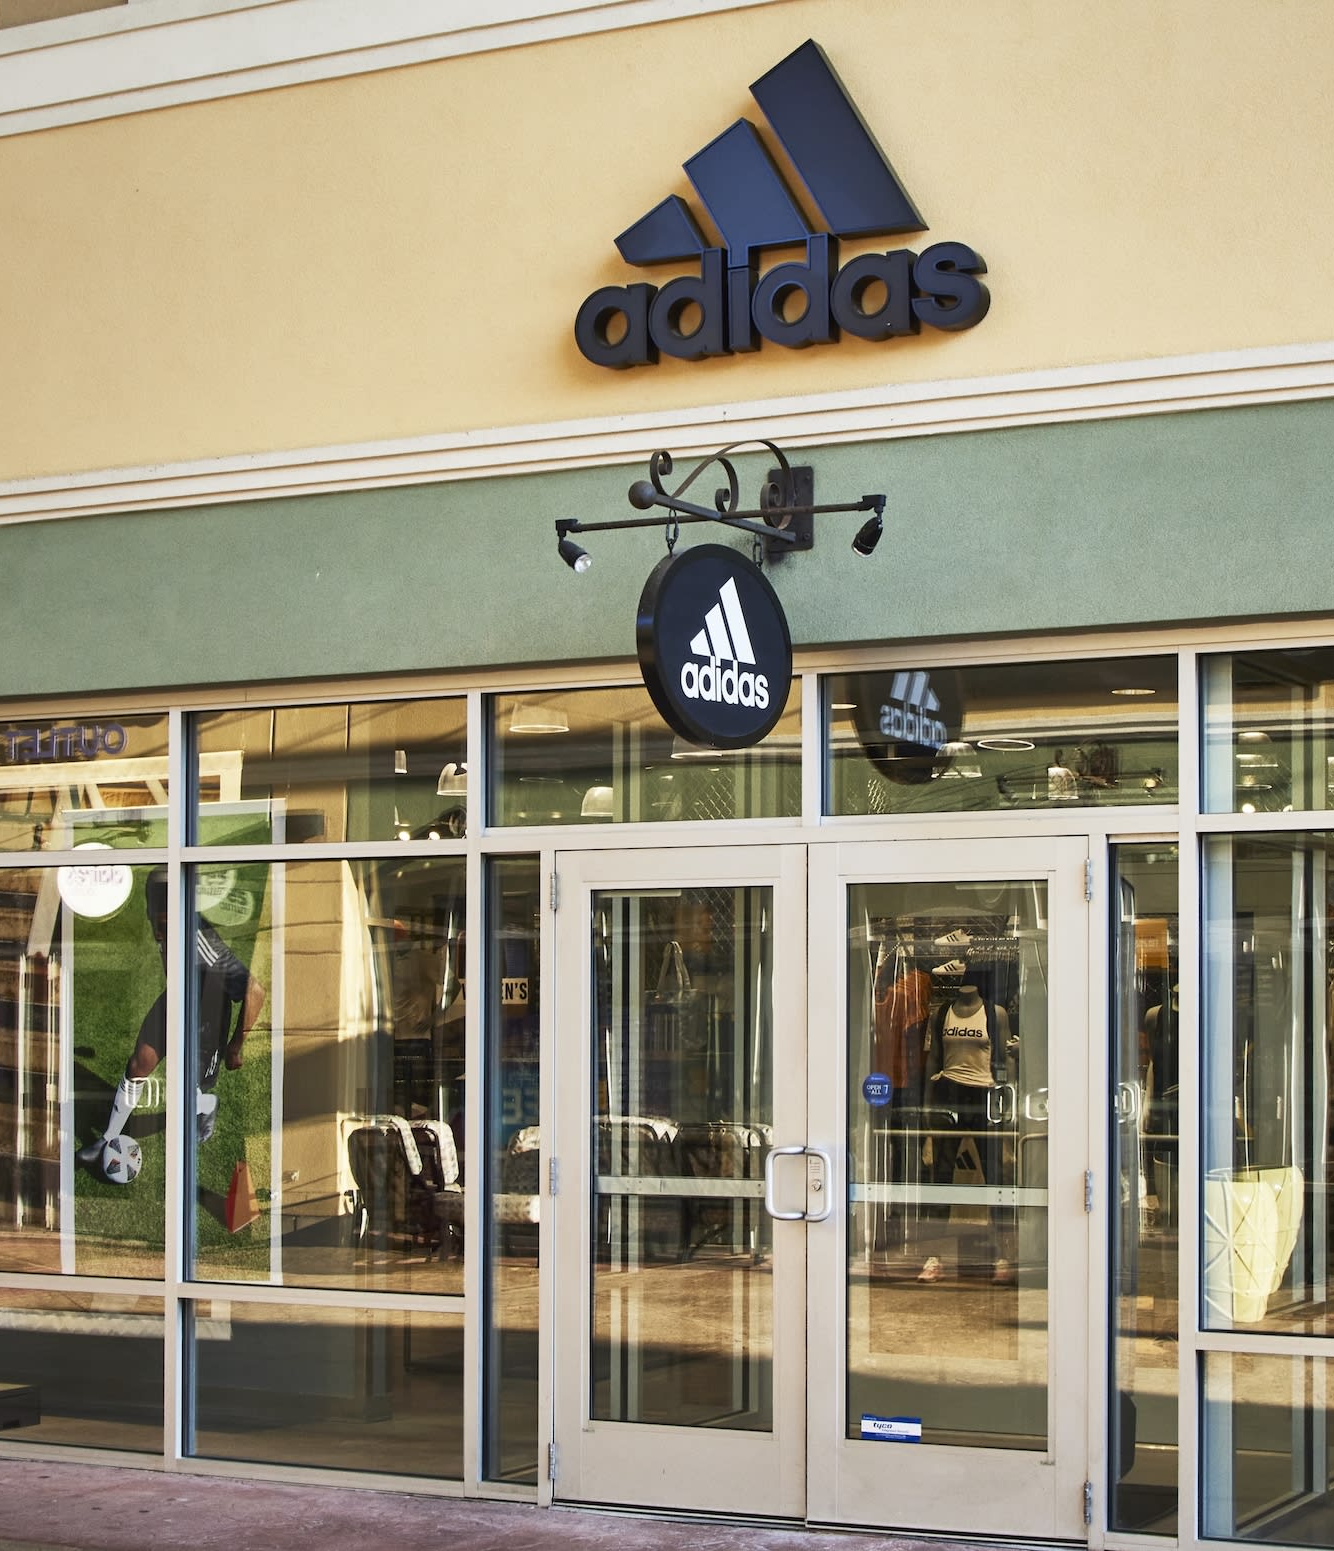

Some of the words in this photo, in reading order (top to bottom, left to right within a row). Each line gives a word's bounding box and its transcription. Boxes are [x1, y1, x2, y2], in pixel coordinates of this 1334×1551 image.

[575, 232, 991, 369] adidas
[680, 656, 770, 710] adidas
[873, 1422, 893, 1430] tyco
